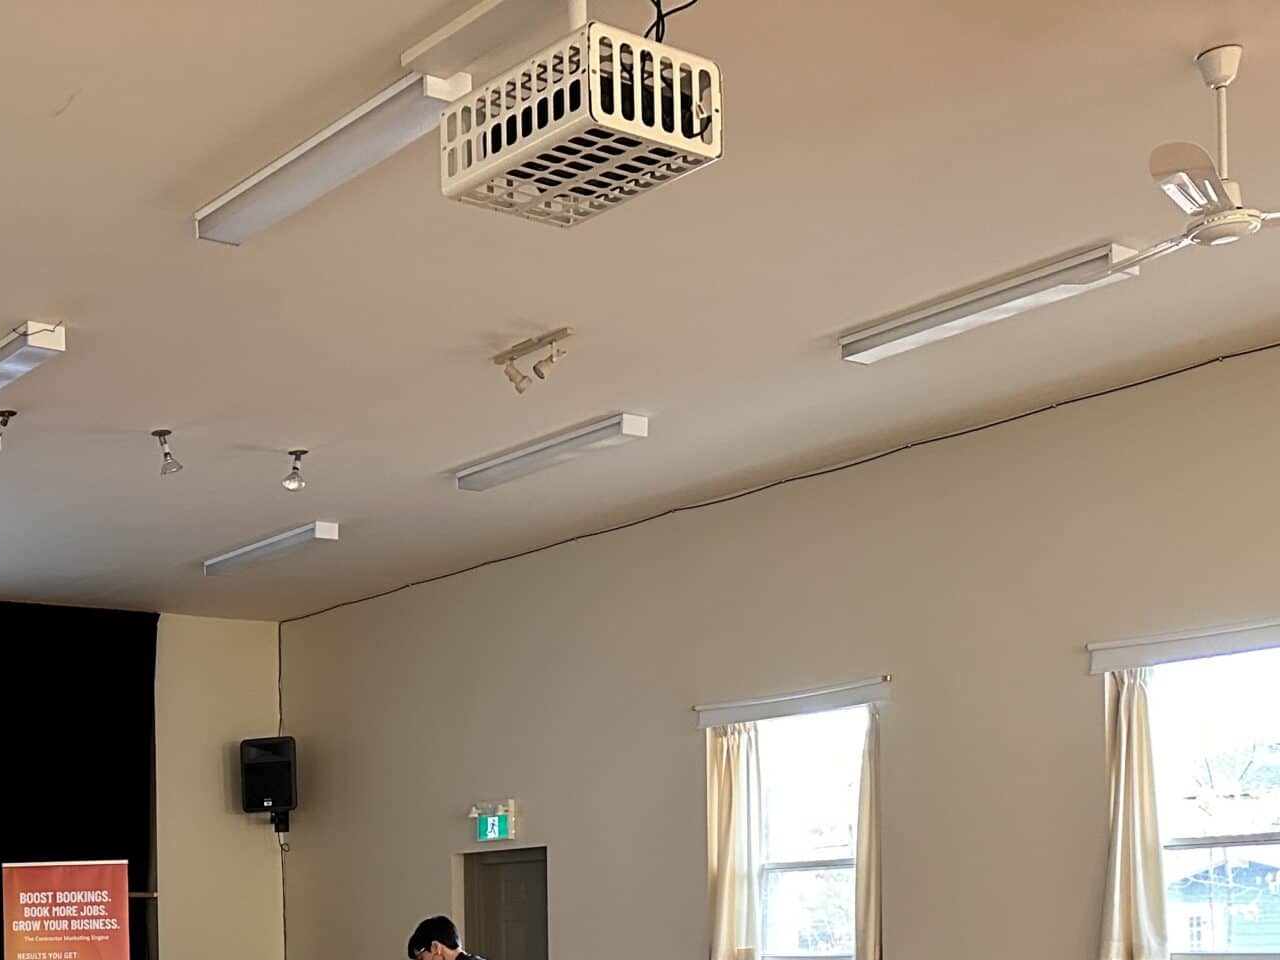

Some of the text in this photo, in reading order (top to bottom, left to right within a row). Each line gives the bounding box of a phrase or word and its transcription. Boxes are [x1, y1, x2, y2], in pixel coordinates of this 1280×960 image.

[20, 891, 112, 904] BOOST BOOKINGS.
[24, 905, 108, 917] BOOK MORE JOBS.
[12, 919, 120, 931] GROW YOUR BUSINESS.
[17, 952, 47, 960] RESULTS
